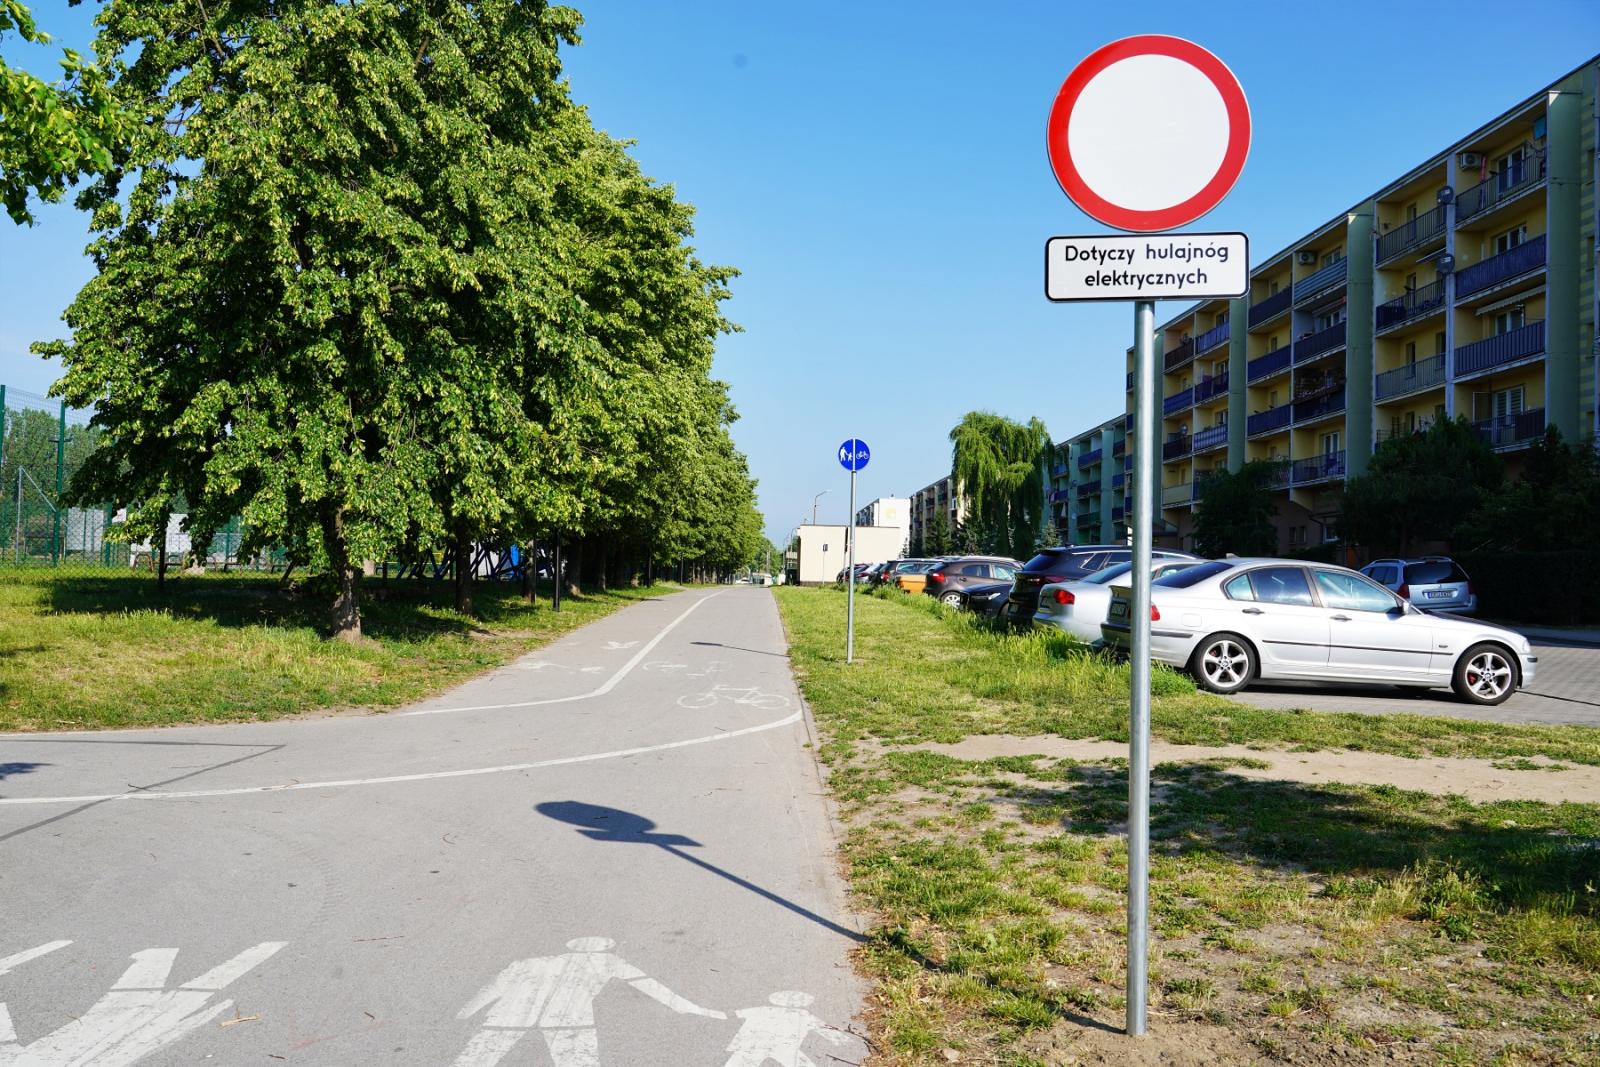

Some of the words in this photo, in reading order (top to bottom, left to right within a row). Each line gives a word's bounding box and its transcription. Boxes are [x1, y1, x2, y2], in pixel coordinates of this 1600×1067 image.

[1065, 244, 1136, 266] Dotyczy
[1146, 242, 1229, 263] hulajnóg
[1084, 268, 1208, 290] elektrycznych
